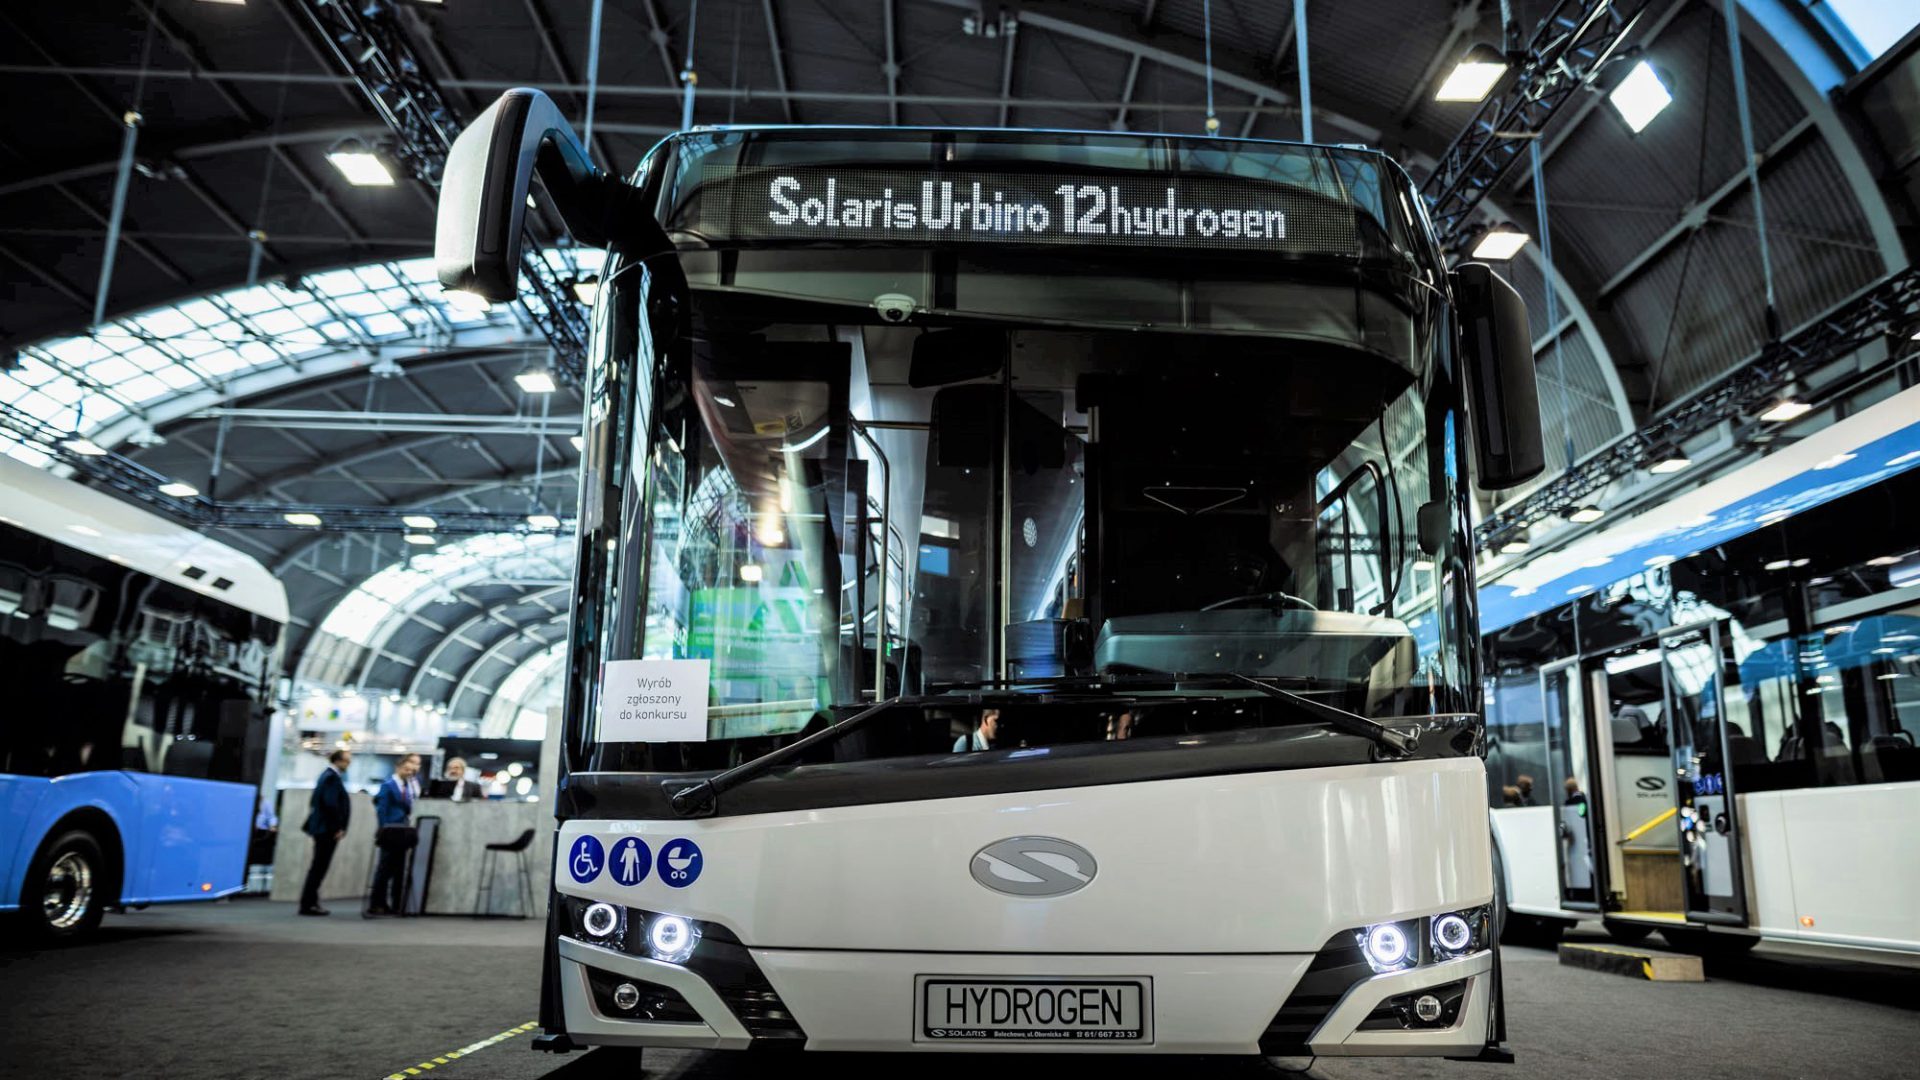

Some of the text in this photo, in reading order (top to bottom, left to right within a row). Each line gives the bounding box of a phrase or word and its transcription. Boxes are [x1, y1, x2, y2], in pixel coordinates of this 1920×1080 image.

[636, 677, 672, 691] Wyrób
[626, 694, 682, 706] zgłoszony
[619, 709, 687, 720] do konkursu
[946, 987, 1122, 1025] HYDROGEN
[947, 1029, 987, 1037] SOLARIS
[1115, 1031, 1126, 1039] 23
[1127, 1031, 1138, 1039] 33
